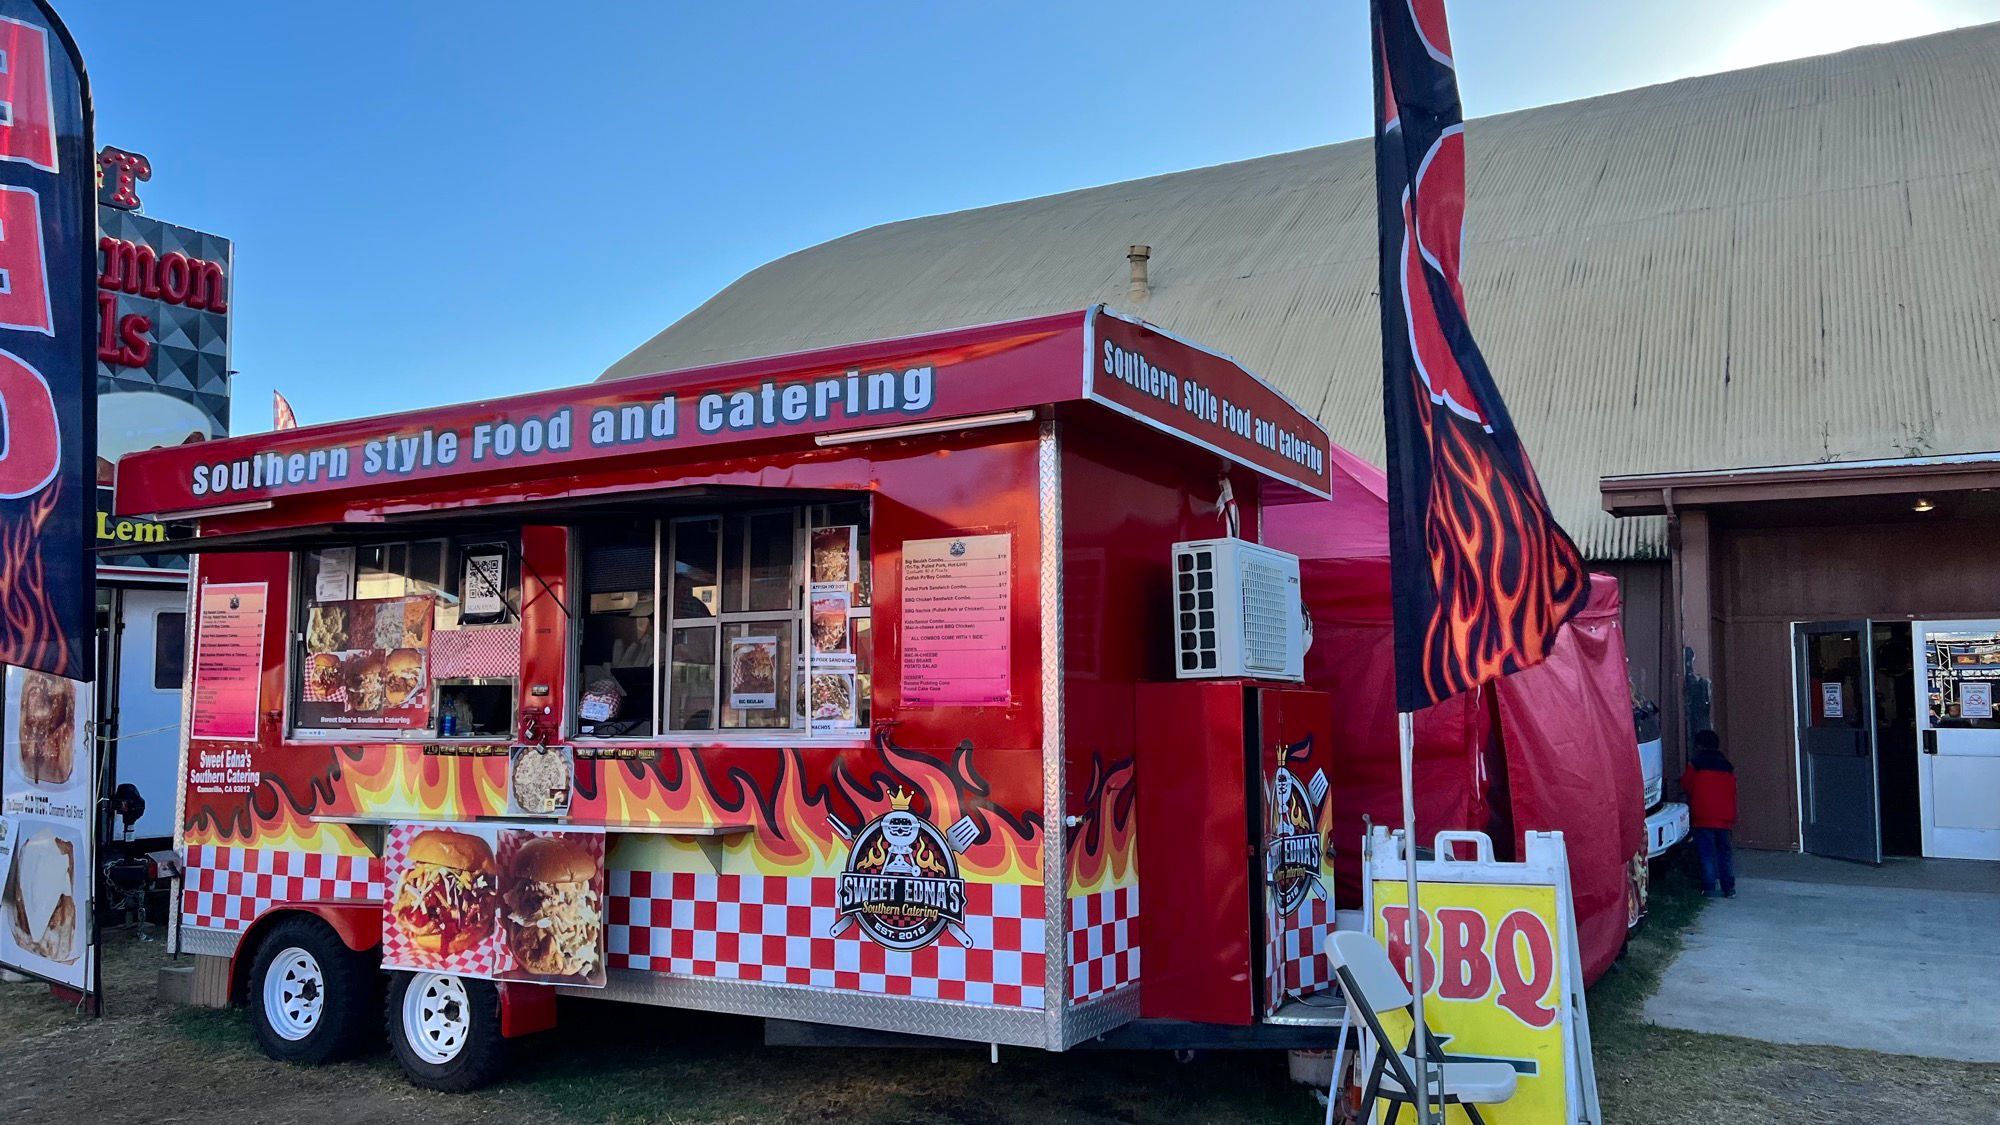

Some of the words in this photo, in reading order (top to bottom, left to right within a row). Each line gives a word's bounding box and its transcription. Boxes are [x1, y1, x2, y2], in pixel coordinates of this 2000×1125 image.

[591, 396, 676, 445] and
[1255, 417, 1276, 451] and
[384, 716, 410, 725] Catering
[200, 750, 224, 768] Sweet
[226, 749, 252, 768] Edna's
[190, 769, 225, 783] Southern
[226, 768, 260, 786] Catering
[1284, 835, 1318, 868] EDNA'S
[842, 876, 898, 906] SWEET
[904, 878, 960, 914] EDNA'S
[862, 901, 900, 916] Southern
[902, 904, 939, 922] Catering
[874, 922, 896, 940] EST.
[898, 925, 927, 940] 2018
[1380, 904, 1556, 1030] BBQ
